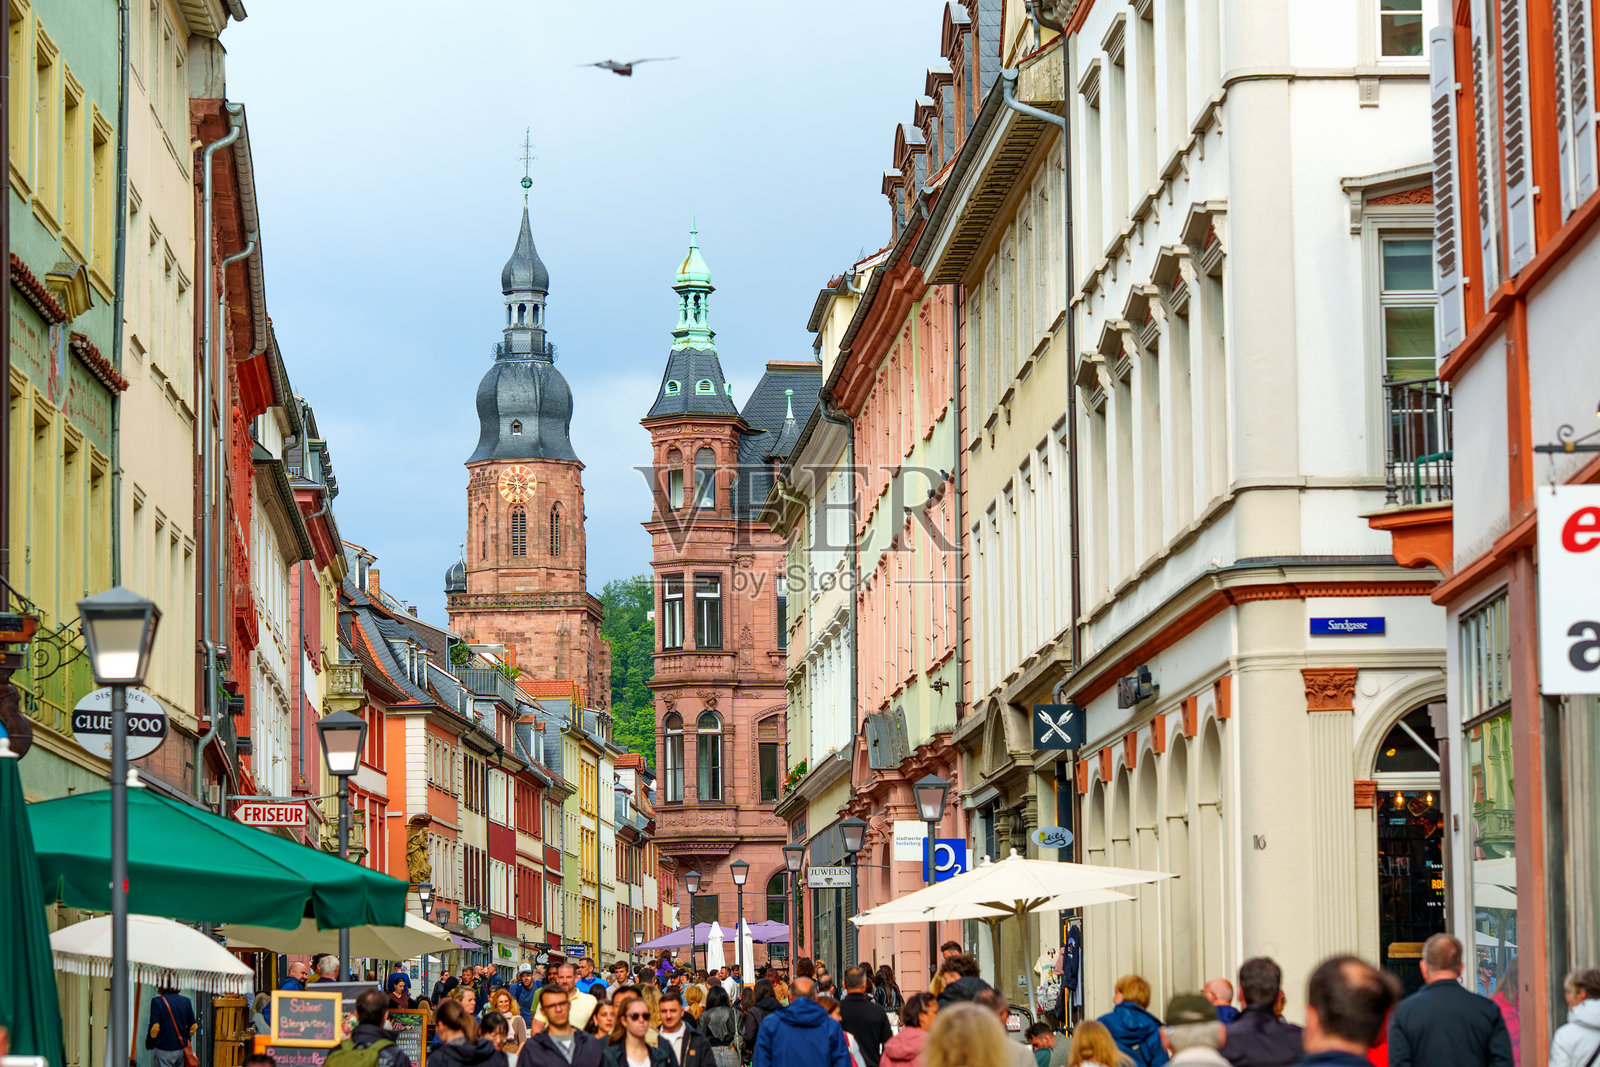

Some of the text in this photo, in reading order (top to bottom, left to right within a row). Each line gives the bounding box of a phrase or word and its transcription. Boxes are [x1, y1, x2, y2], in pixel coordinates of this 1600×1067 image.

[1327, 619, 1368, 632] Sandgasse
[125, 715, 161, 732] 900
[244, 807, 303, 822] FRISEUR
[1252, 834, 1266, 850] 16
[810, 868, 850, 876] JUWELEN
